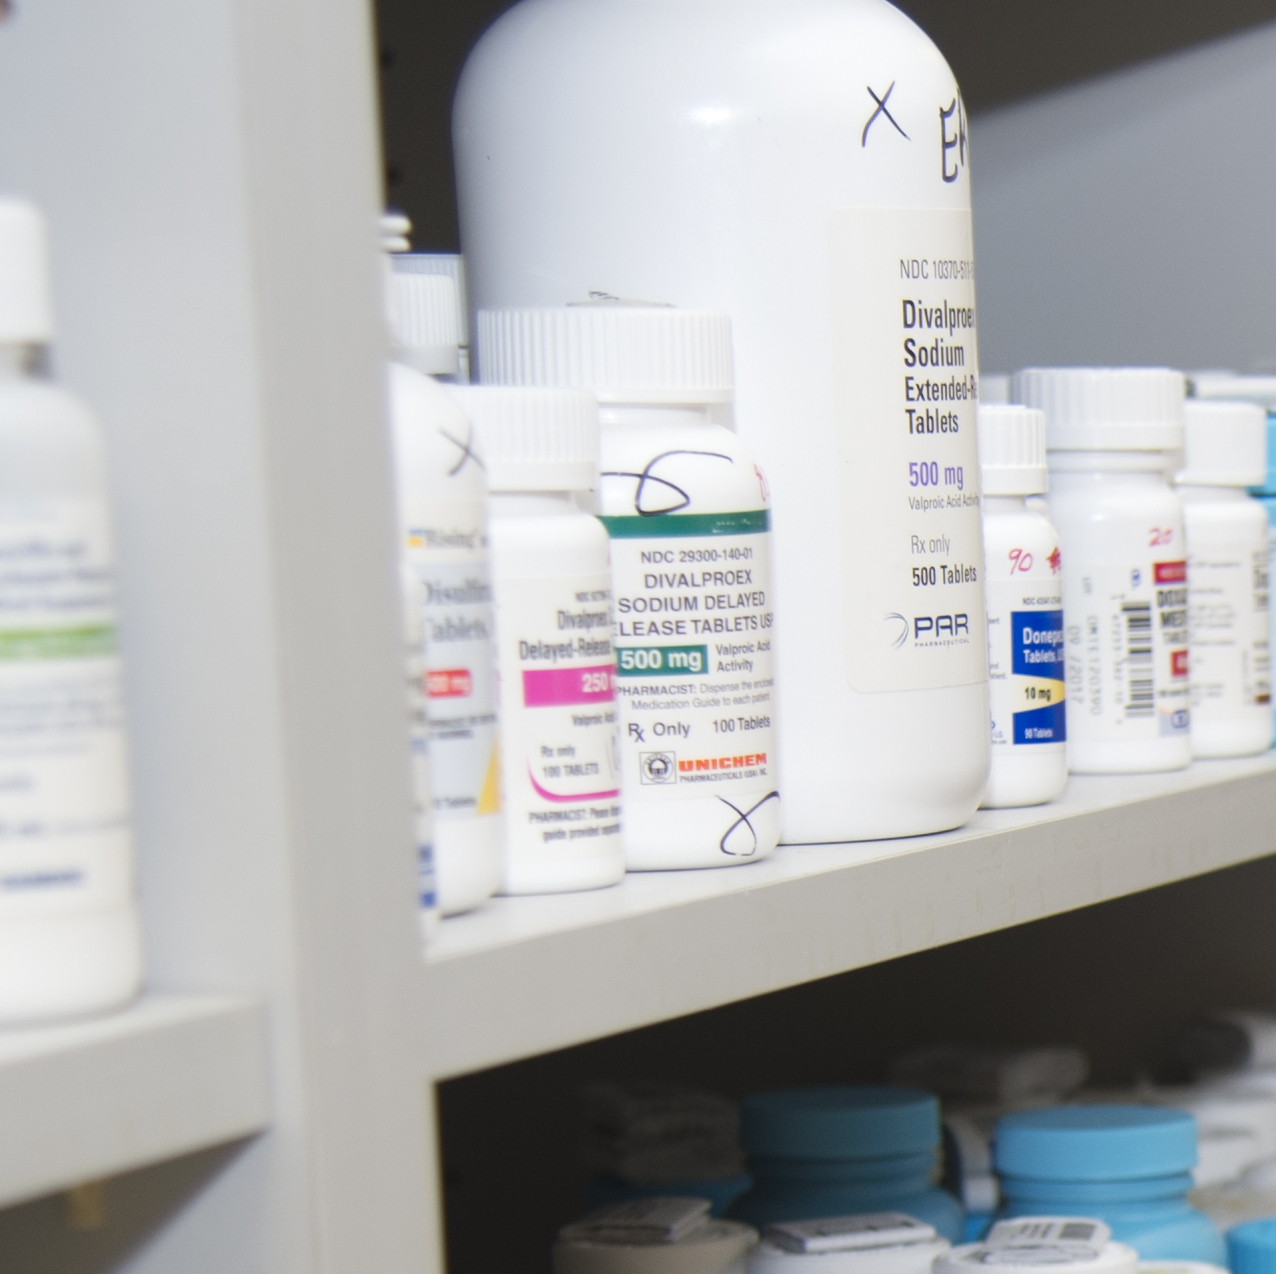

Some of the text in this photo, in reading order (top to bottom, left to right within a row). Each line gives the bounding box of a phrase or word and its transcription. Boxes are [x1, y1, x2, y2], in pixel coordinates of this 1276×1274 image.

[900, 259, 929, 280] NDC
[904, 338, 964, 368] Sodium
[905, 408, 959, 435] Tablets
[909, 461, 964, 491] 500 mg
[908, 496, 945, 512] Valproic
[641, 547, 753, 563] NDC 29300-140-01
[911, 534, 950, 556] Rx only
[1009, 548, 1033, 575] 90
[644, 570, 752, 589] DIVALPROEX
[912, 563, 977, 587] 500 Tablets
[618, 591, 765, 614] SODIUM DELAYED
[614, 615, 758, 636] LEASE TABLETS
[914, 613, 969, 639] PAR
[621, 649, 703, 672] 500 mg
[716, 644, 755, 658] Valproic
[1023, 649, 1058, 664] Tablets,
[717, 659, 753, 673] Activity
[582, 672, 609, 693] 250
[699, 682, 740, 695] Dispense
[632, 700, 690, 711] Medication
[693, 697, 720, 709] Guide
[723, 695, 731, 706] to
[1025, 687, 1051, 702] 10 mg
[653, 722, 690, 739] Only
[713, 719, 735, 733] 100
[737, 716, 771, 731] Tablets
[564, 762, 599, 777] TABLETS
[678, 753, 767, 772] UNICHEM
[680, 770, 742, 783] PHARMACEUTICALS
